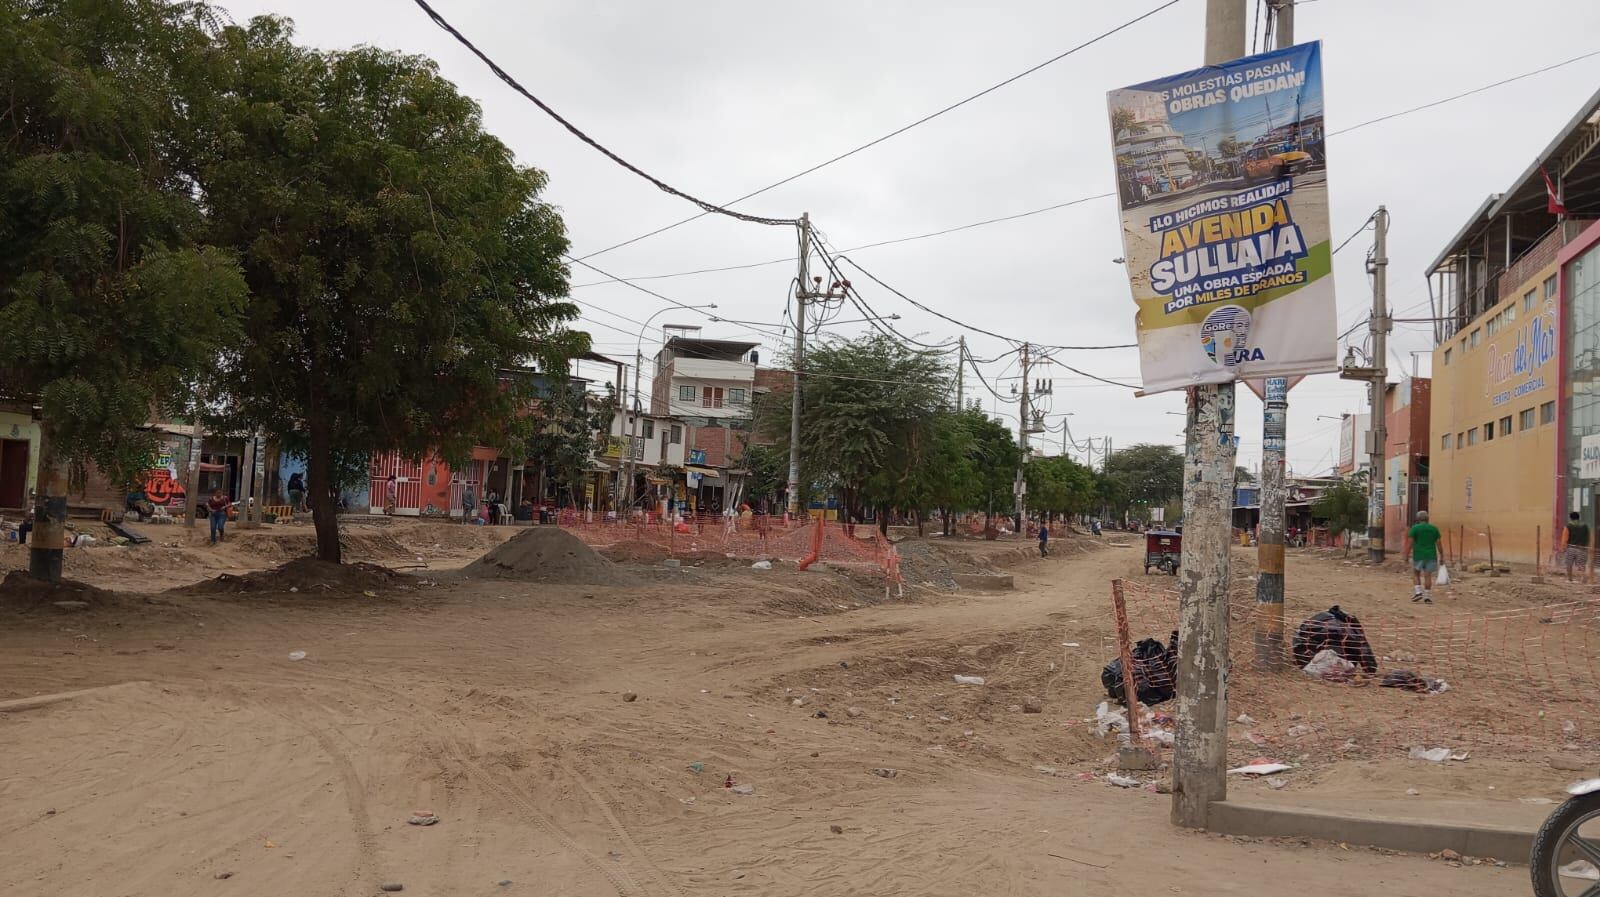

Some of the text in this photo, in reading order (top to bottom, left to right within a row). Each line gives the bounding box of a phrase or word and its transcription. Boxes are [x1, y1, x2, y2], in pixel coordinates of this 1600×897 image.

[1169, 89, 1227, 114] OBRAS
[1230, 71, 1305, 103] QUEDAN!
[1172, 72, 1243, 99] MOLESTIAS
[1175, 197, 1228, 223] HICIMOS
[1162, 200, 1288, 257] AVENIDA
[1168, 296, 1194, 312] POR
[1196, 288, 1232, 304] MILES
[1234, 285, 1250, 295] DE
[1174, 282, 1202, 298] UNA
[1204, 275, 1240, 290] OBRA
[1513, 325, 1527, 373] del
[1528, 317, 1554, 376] Mar
[1493, 376, 1545, 405] CENTRO COMERCIAL
